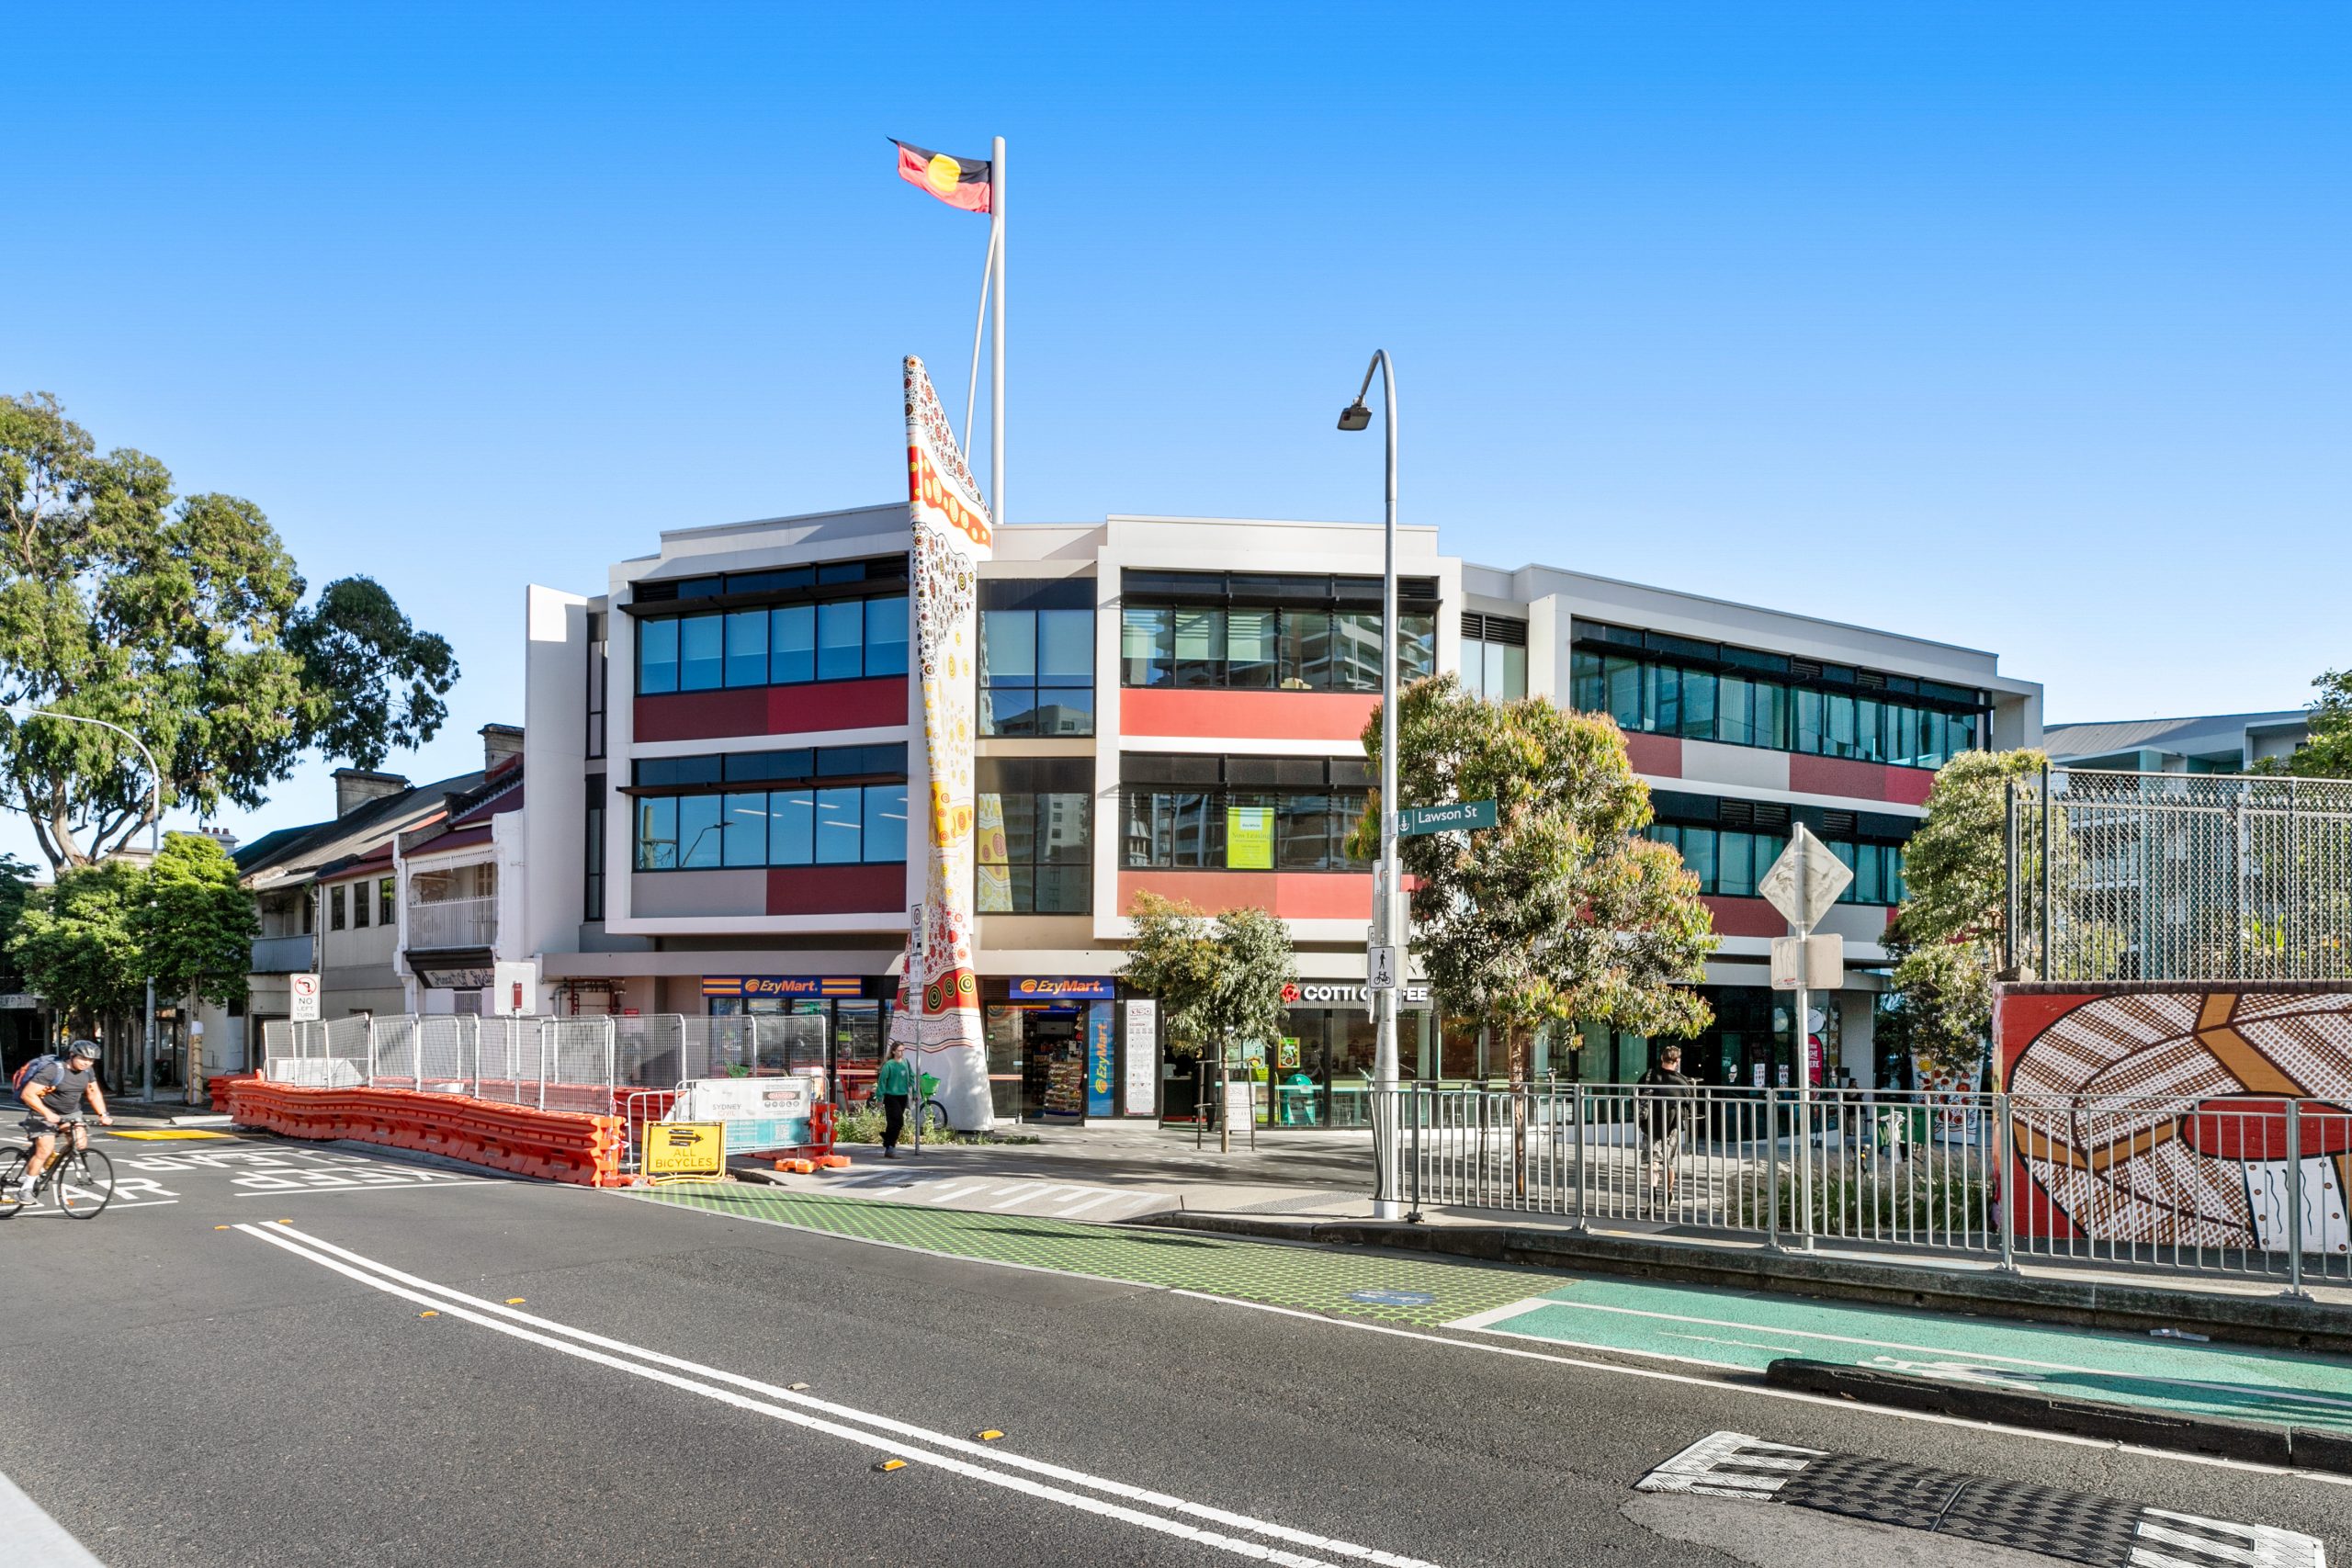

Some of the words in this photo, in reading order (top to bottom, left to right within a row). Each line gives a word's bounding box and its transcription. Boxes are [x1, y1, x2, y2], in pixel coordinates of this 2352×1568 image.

[1418, 810, 1462, 824] Lawson
[1464, 805, 1477, 818] St
[1304, 986, 1356, 1000] COTTI
[1096, 1023, 1111, 1079] EzyMart
[673, 1148, 696, 1157] ALL
[655, 1157, 713, 1168] BICYCLES
